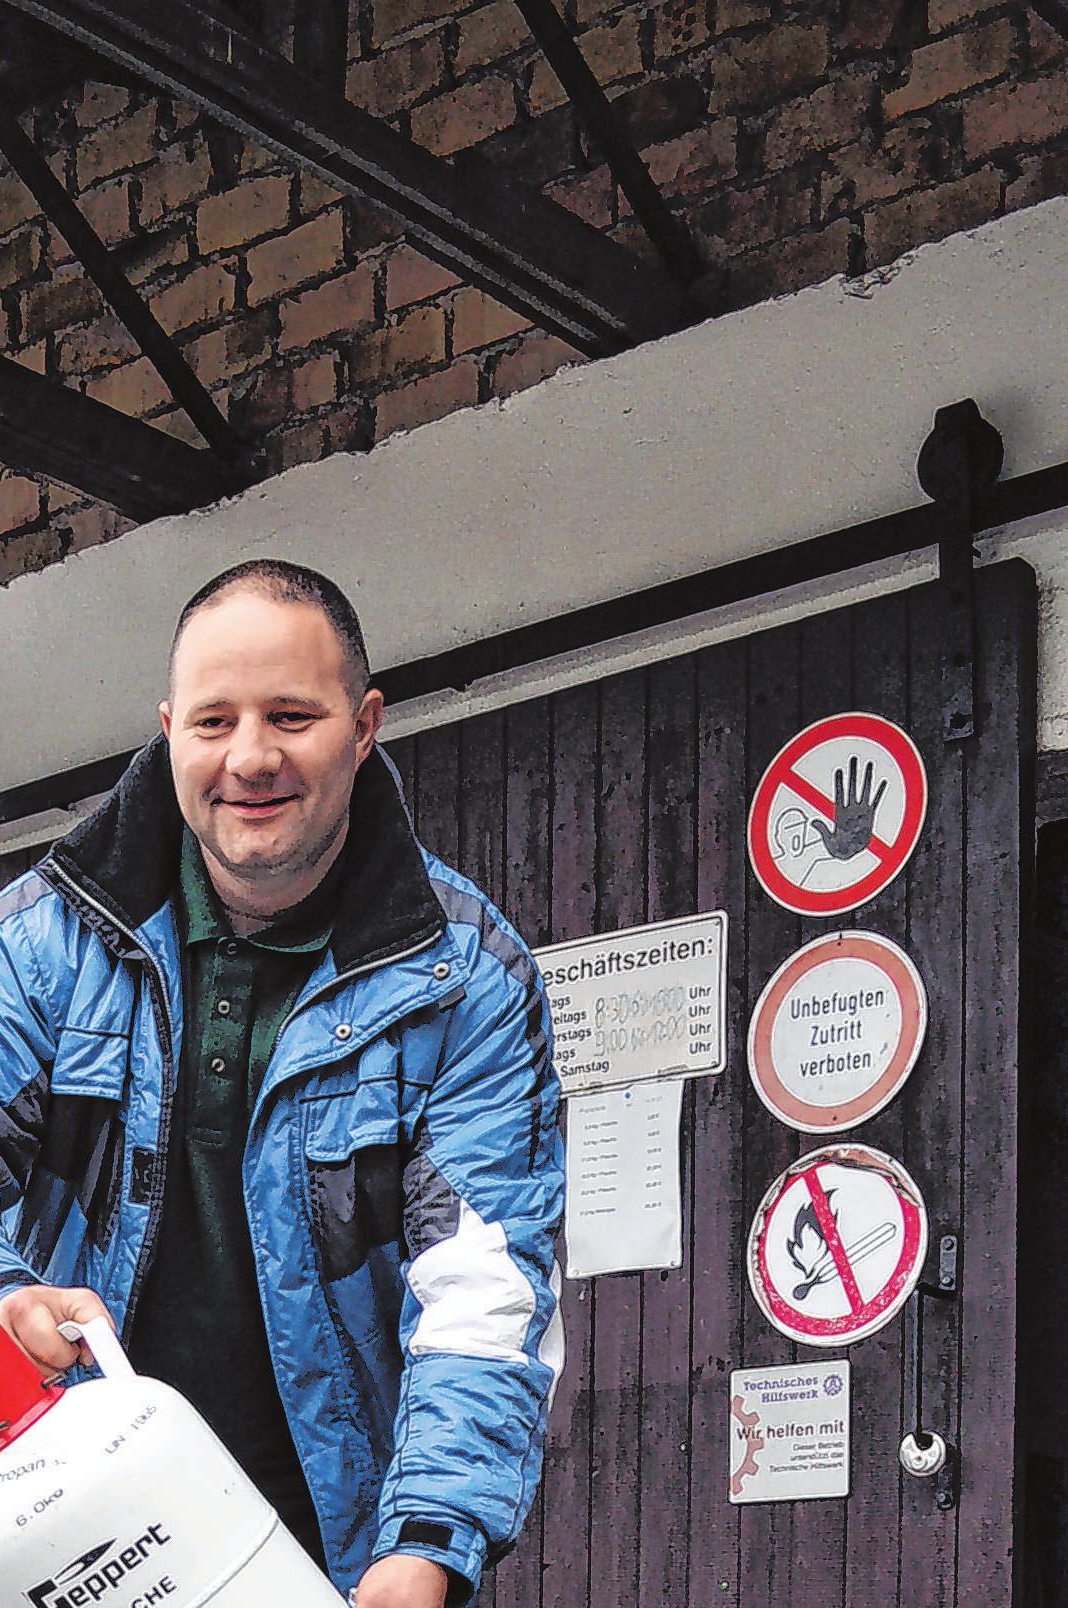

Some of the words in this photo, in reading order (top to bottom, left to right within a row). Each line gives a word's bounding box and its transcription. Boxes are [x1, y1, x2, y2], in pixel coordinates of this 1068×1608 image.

[543, 938, 714, 986] eschäftszeiten:
[689, 986, 711, 999] Uhr
[791, 989, 884, 1019] Unbefugten
[553, 1010, 587, 1026] eitags
[689, 1004, 711, 1018] Uhr
[689, 1023, 711, 1037] Uhr
[810, 1020, 862, 1046] Zutritt
[689, 1041, 711, 1055] Uhr
[560, 1060, 610, 1078] Samstag
[800, 1051, 871, 1077] verboten
[743, 1376, 819, 1391] Technisches
[761, 1391, 819, 1403] Hilfswerk
[737, 1426, 762, 1440] Wir
[767, 1423, 814, 1440] helfen
[819, 1419, 845, 1434] mit
